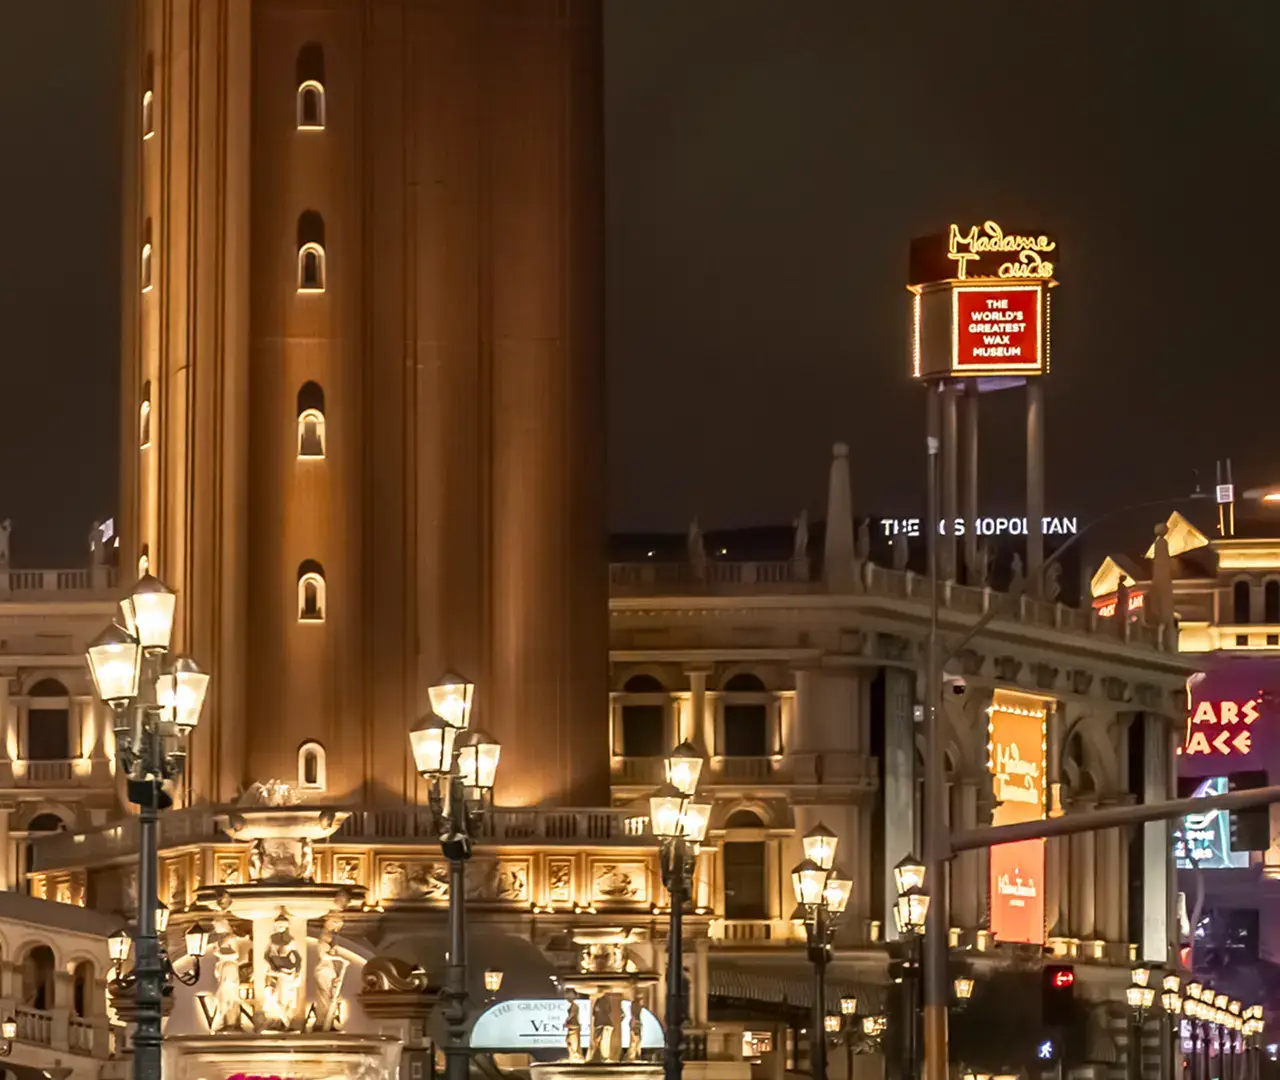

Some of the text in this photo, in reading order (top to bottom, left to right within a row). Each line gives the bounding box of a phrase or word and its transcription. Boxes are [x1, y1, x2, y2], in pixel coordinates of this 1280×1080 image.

[949, 221, 1056, 253] Madame
[986, 299, 1008, 309] THE
[971, 311, 1024, 321] WORLD'S
[968, 323, 1026, 333] GREATEST
[983, 335, 1010, 345] WAX
[972, 347, 1021, 357] MUSEUM
[880, 518, 920, 536] THE
